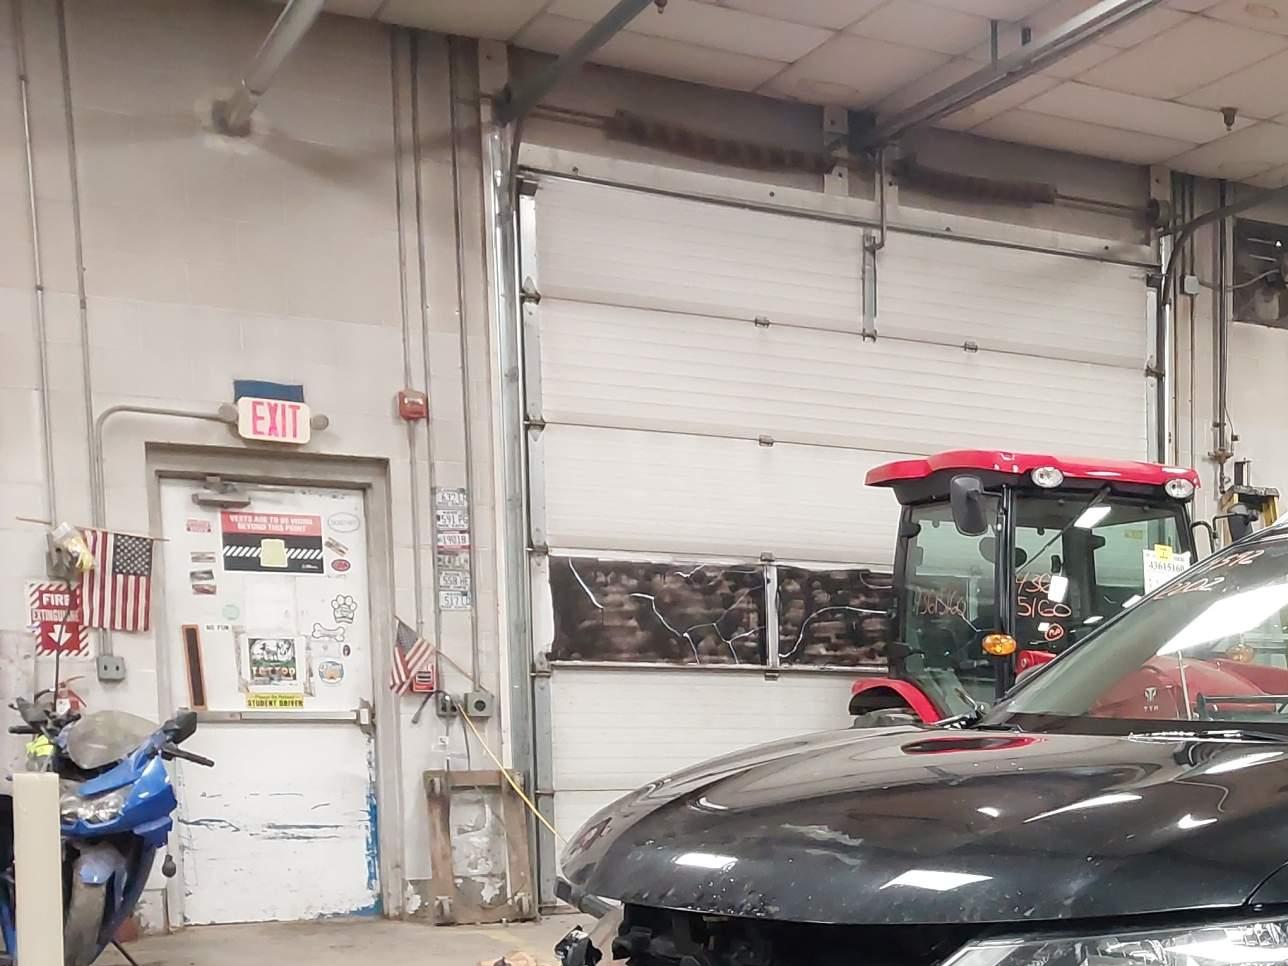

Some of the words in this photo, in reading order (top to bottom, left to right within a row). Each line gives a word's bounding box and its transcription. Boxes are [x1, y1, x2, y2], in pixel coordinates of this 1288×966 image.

[252, 401, 301, 439] EXIT
[42, 592, 70, 606] FIRE
[1017, 596, 1072, 618] 5160
